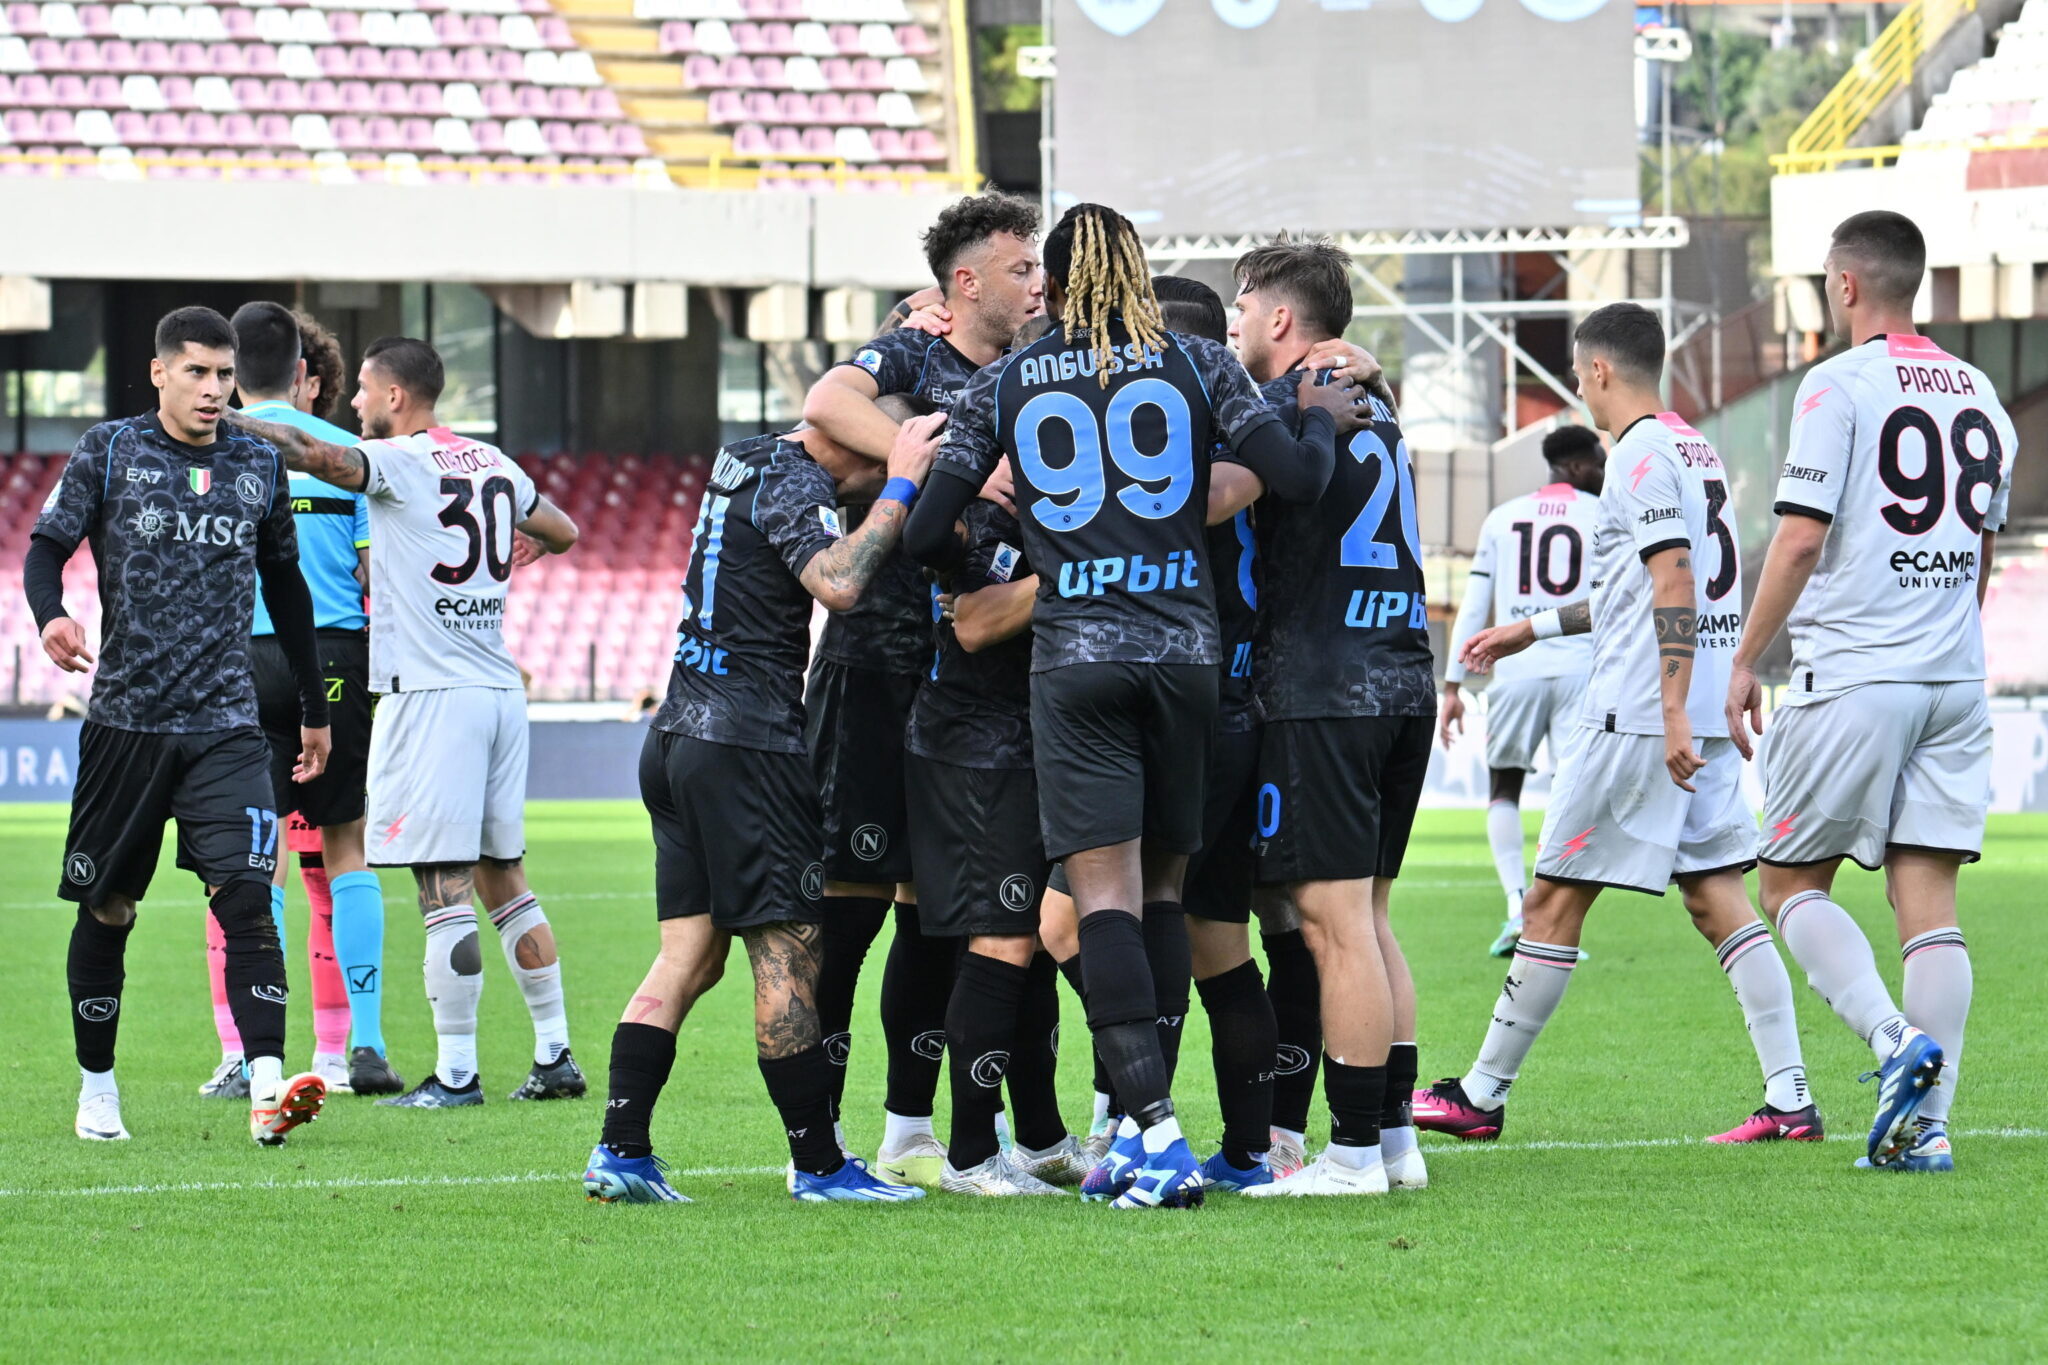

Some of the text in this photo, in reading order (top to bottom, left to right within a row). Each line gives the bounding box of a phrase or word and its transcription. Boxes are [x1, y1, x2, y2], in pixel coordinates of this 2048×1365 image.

[1020, 342, 1164, 387] ANGUSSA
[1896, 365, 1976, 396] PIROLA
[126, 467, 163, 485] EA7
[1014, 377, 1194, 532] 99
[1878, 404, 2004, 536] 98
[430, 476, 516, 586] 30
[1538, 502, 1567, 518] DIA
[1511, 521, 1584, 597] 10
[1703, 478, 1739, 602] 3
[246, 806, 278, 856] 17
[1258, 783, 1280, 838] 0
[249, 853, 276, 871] EA7
[1155, 1015, 1182, 1027] A7
[1258, 1071, 1275, 1082] EA
